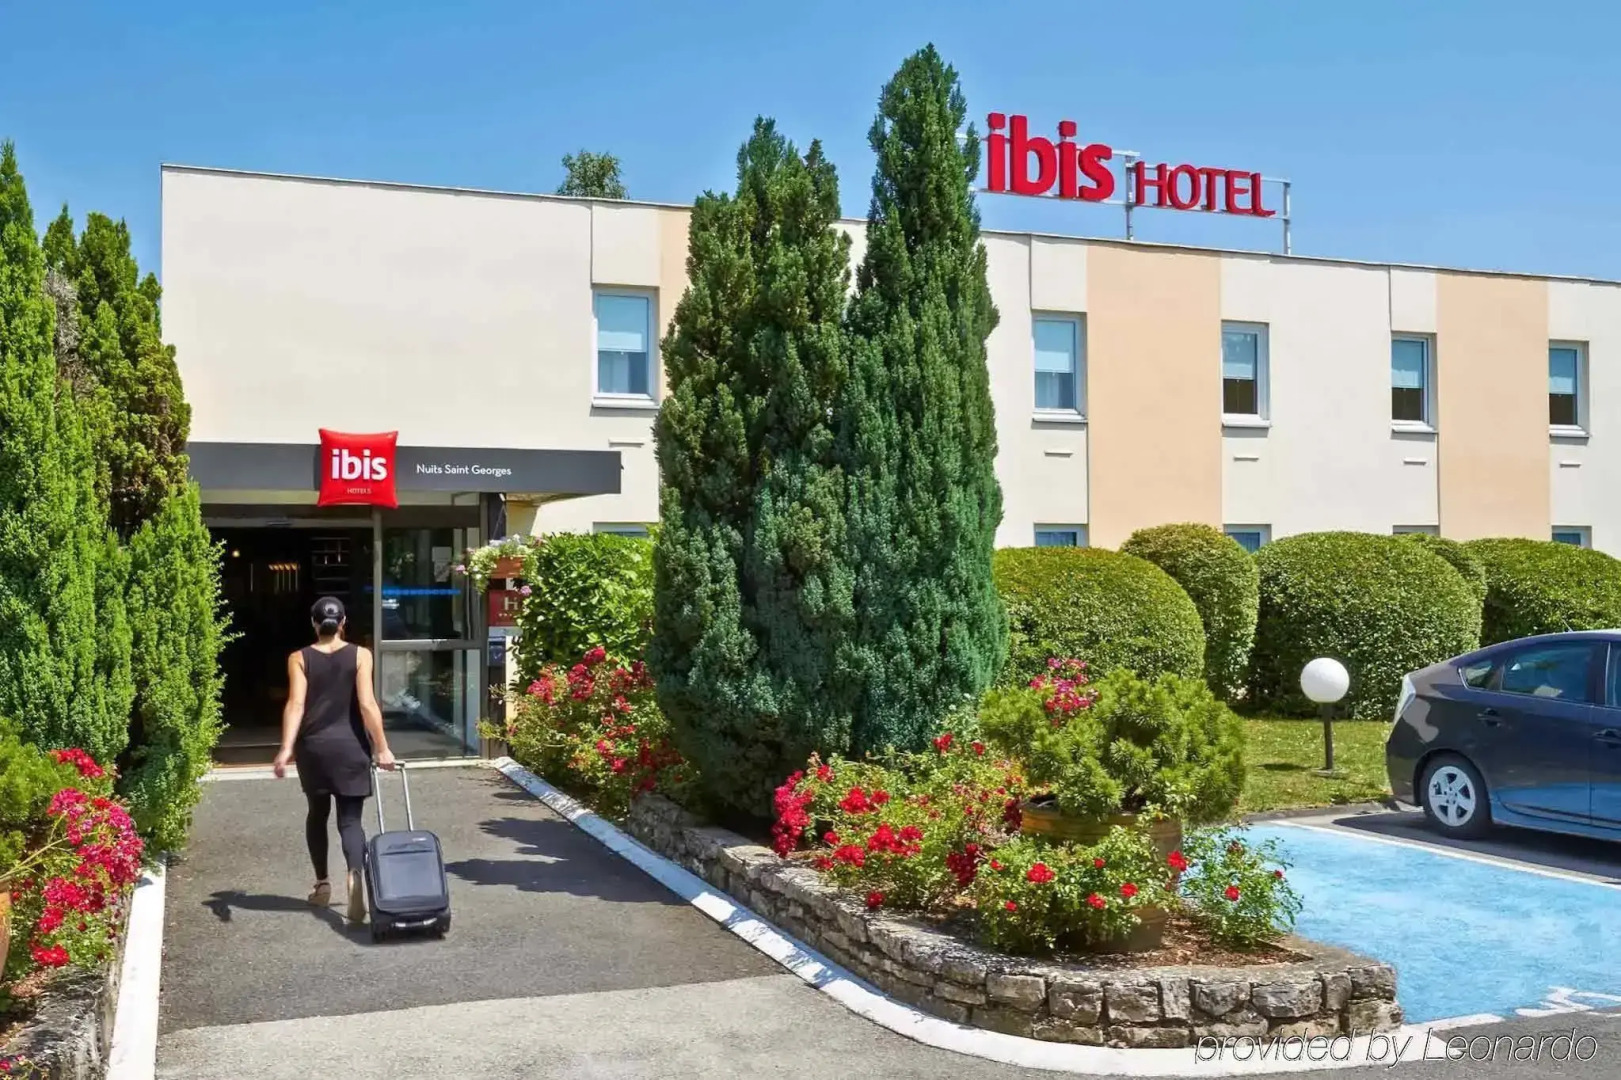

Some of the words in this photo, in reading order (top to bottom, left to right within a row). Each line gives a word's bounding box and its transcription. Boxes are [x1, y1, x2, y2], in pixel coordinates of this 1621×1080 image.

[988, 112, 1115, 201] ibis
[1135, 161, 1277, 217] HOTEL
[331, 448, 388, 481] ibis
[416, 463, 443, 474] Nuits
[444, 464, 470, 475] Saint
[471, 465, 512, 477] Georges
